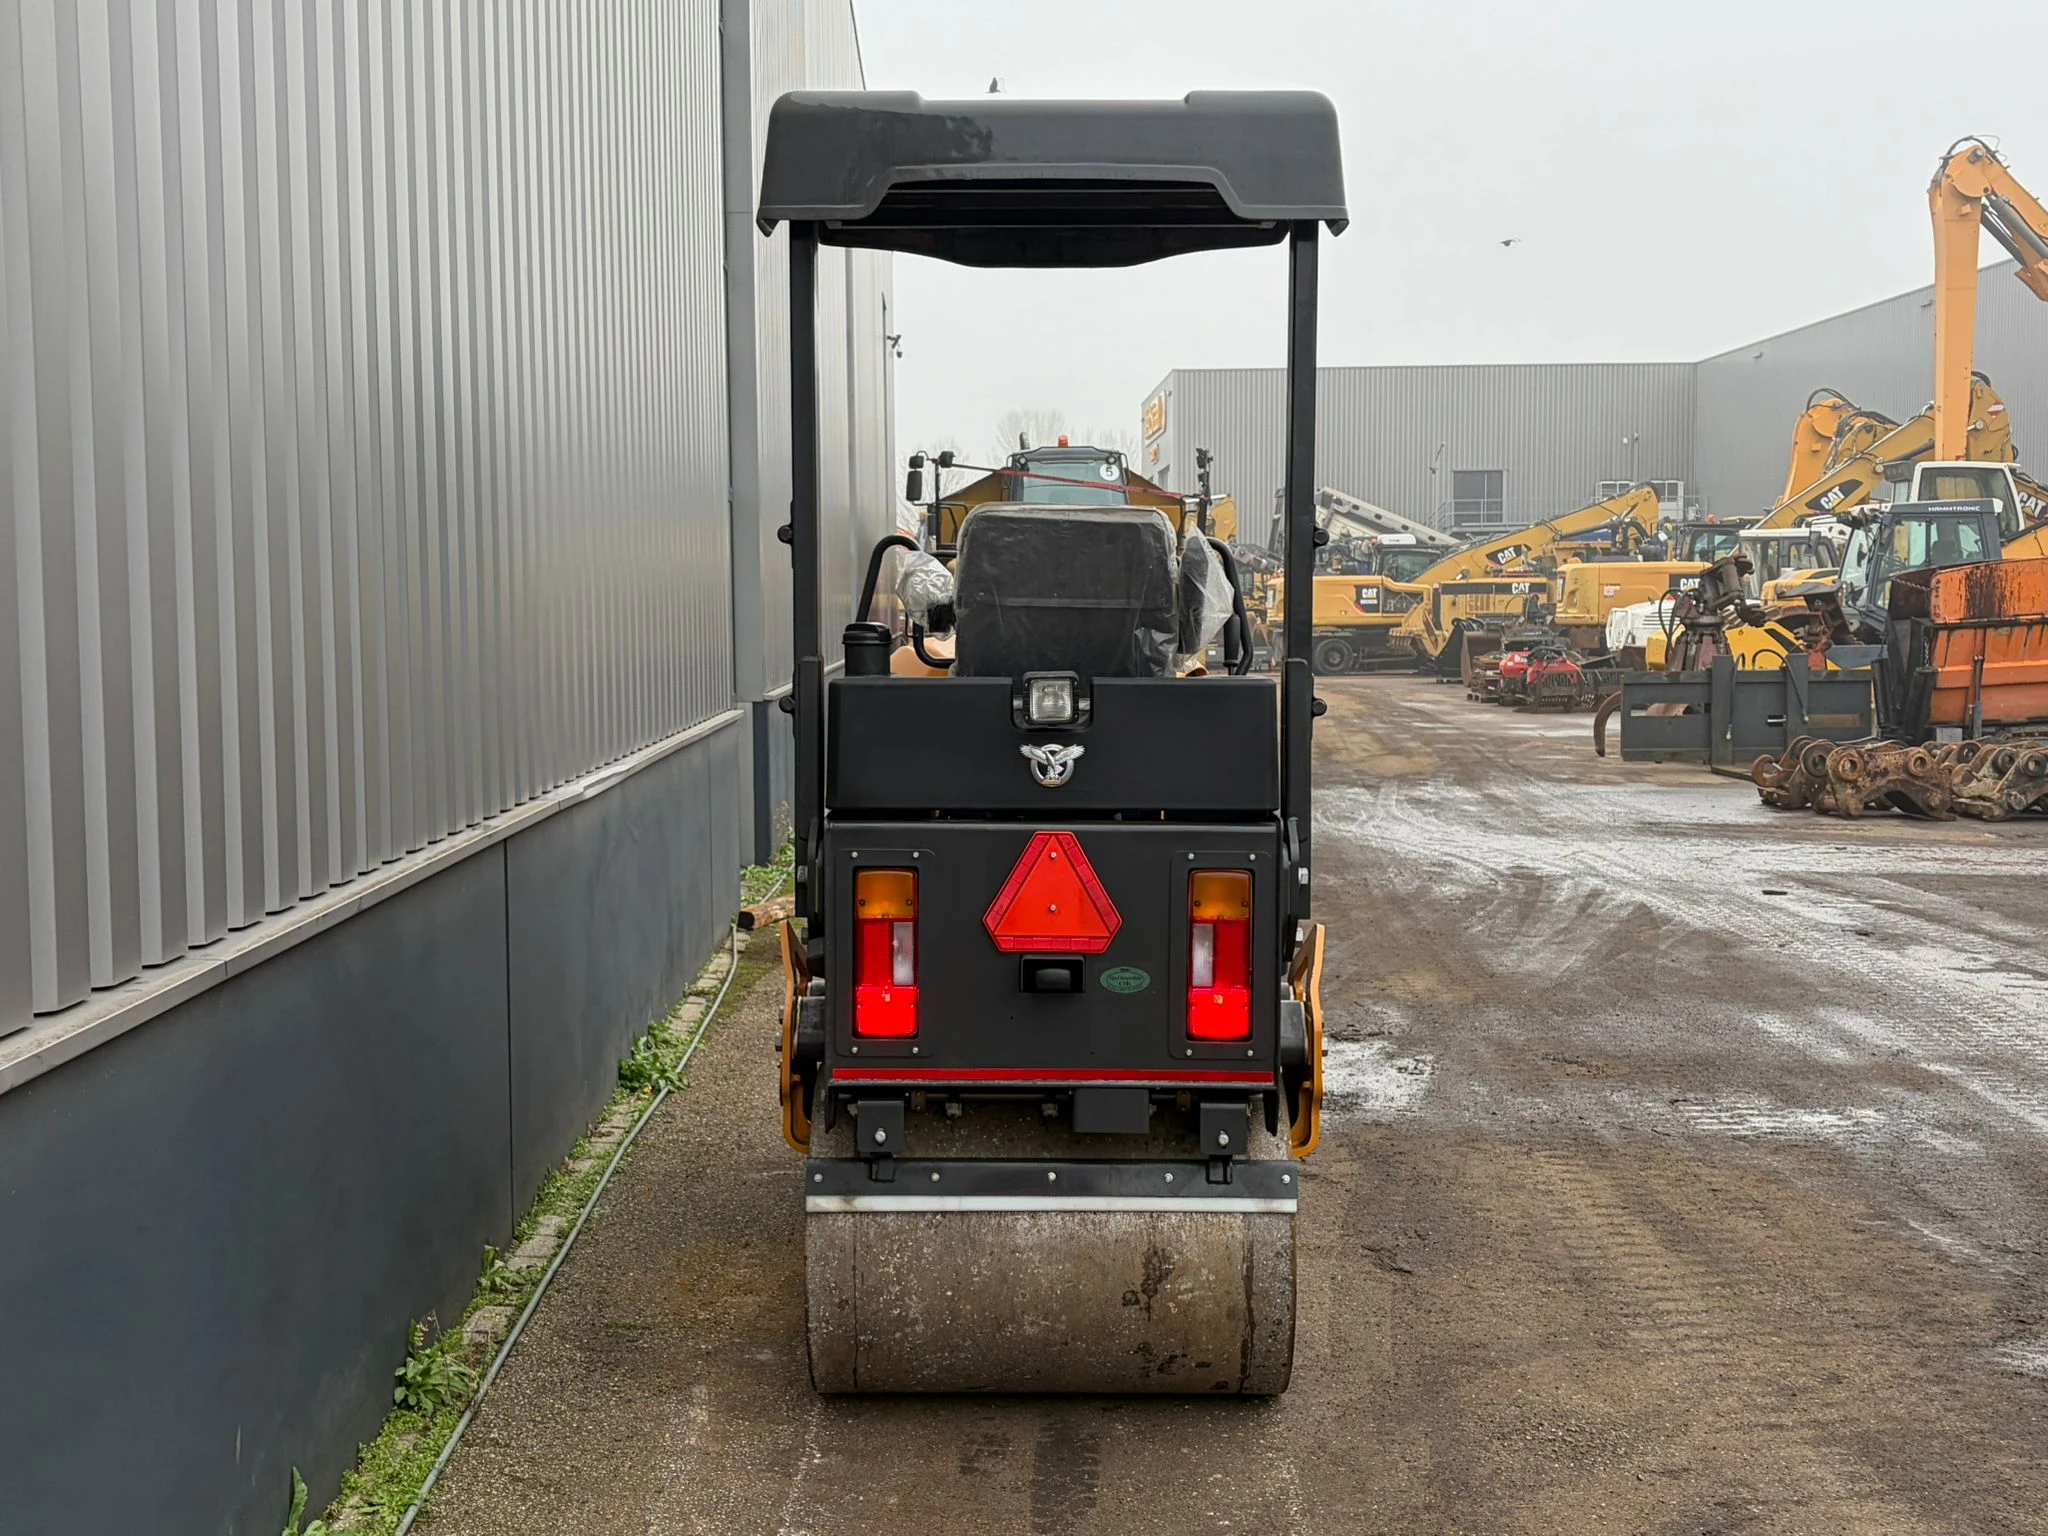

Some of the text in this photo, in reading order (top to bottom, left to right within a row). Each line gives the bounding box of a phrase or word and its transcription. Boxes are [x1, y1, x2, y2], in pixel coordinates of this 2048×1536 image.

[1105, 466, 1114, 477] 5
[1820, 485, 1845, 510] CAT
[2018, 491, 2047, 518] CAT
[1497, 546, 1517, 564] CAT
[1511, 582, 1531, 594] CAT
[1680, 578, 1701, 591] CAT
[1361, 587, 1378, 599] CAT
